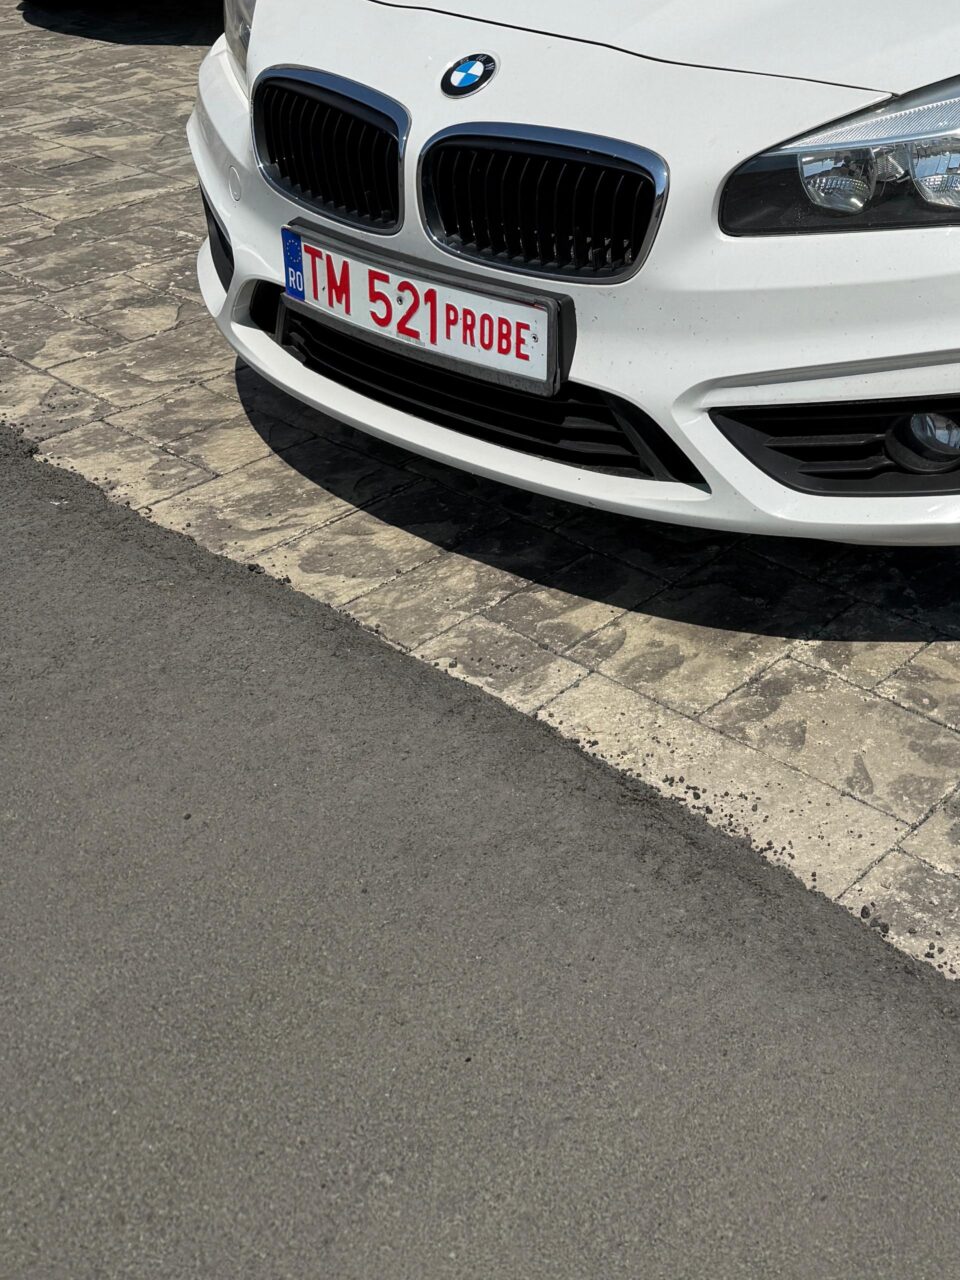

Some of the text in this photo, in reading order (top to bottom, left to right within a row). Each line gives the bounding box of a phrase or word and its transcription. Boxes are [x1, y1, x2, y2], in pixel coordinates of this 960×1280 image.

[288, 268, 304, 293] RO
[303, 243, 531, 362] TM 521 PROBE
